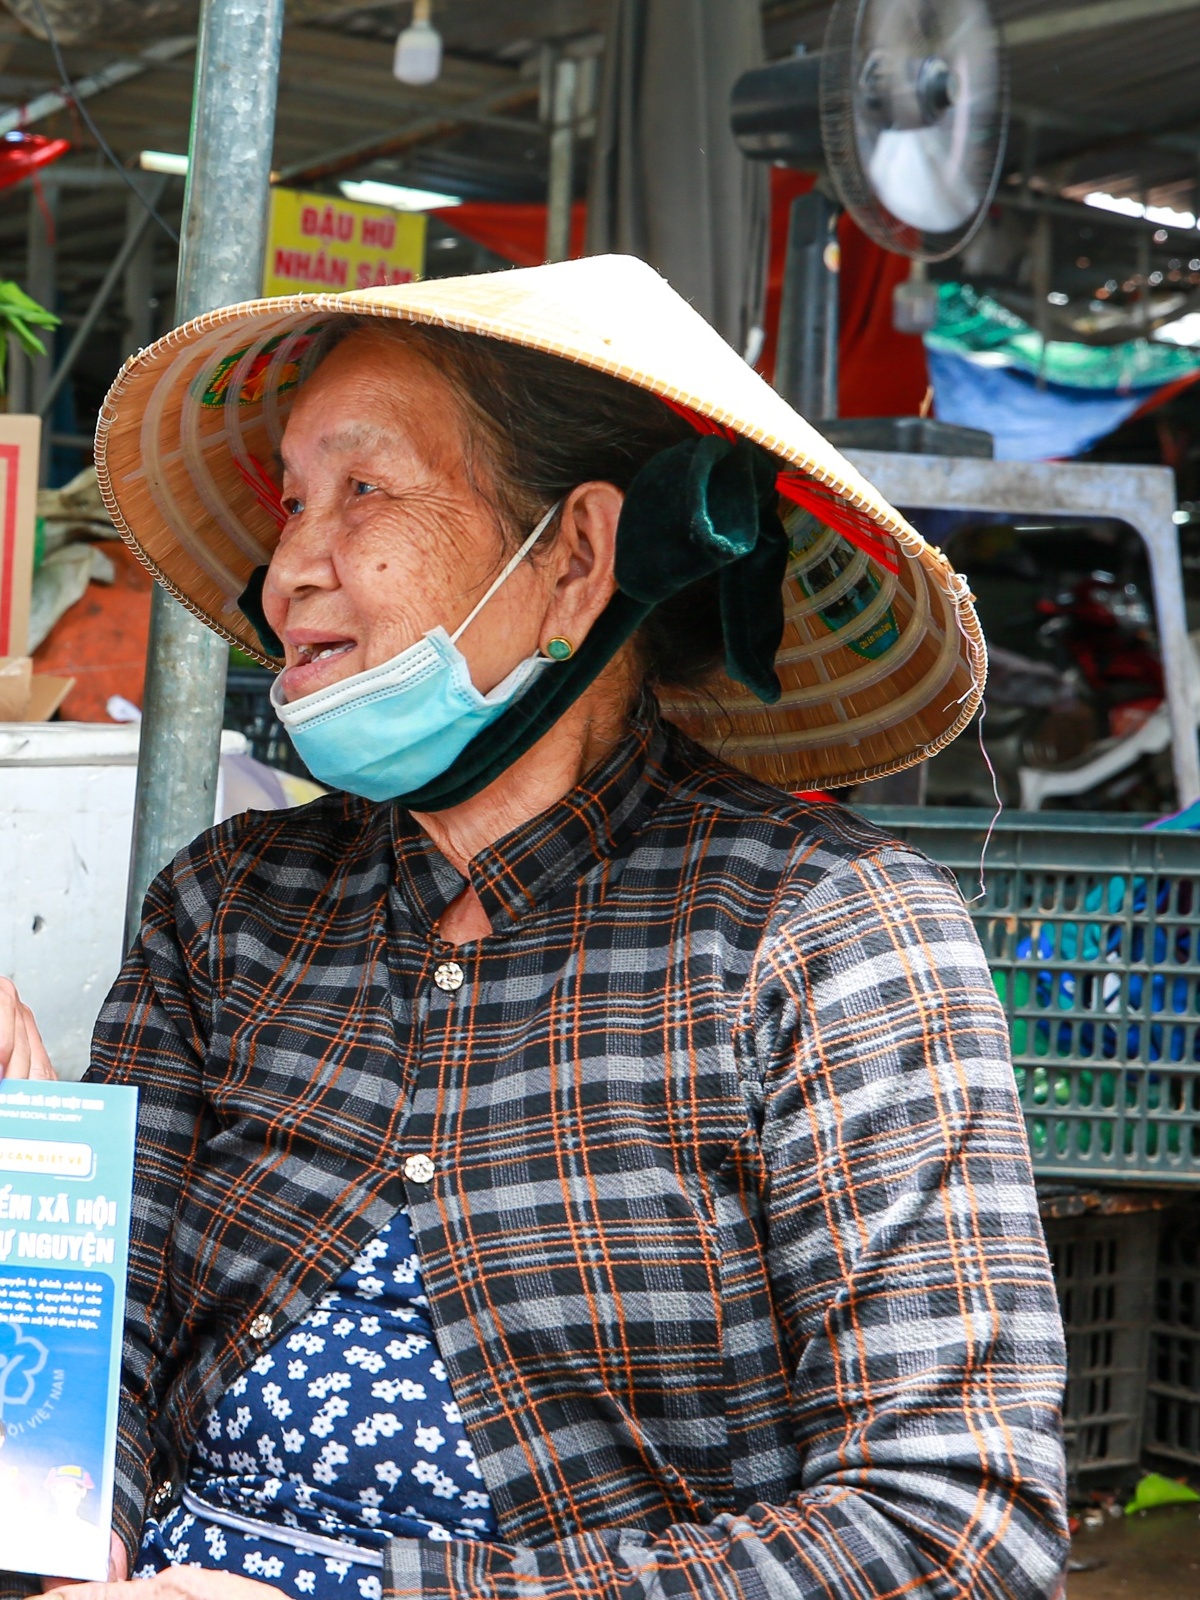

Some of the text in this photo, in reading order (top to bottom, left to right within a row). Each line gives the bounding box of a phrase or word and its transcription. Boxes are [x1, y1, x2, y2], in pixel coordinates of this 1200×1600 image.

[273, 249, 348, 288] NHÂN
[36, 1193, 70, 1224] XÃ
[75, 1195, 117, 1231] HỘI
[17, 1231, 115, 1268] NGUYỆN
[7, 1422, 25, 1438] ỘI
[26, 1399, 55, 1430] VIỆT
[49, 1369, 65, 1400] NAM
